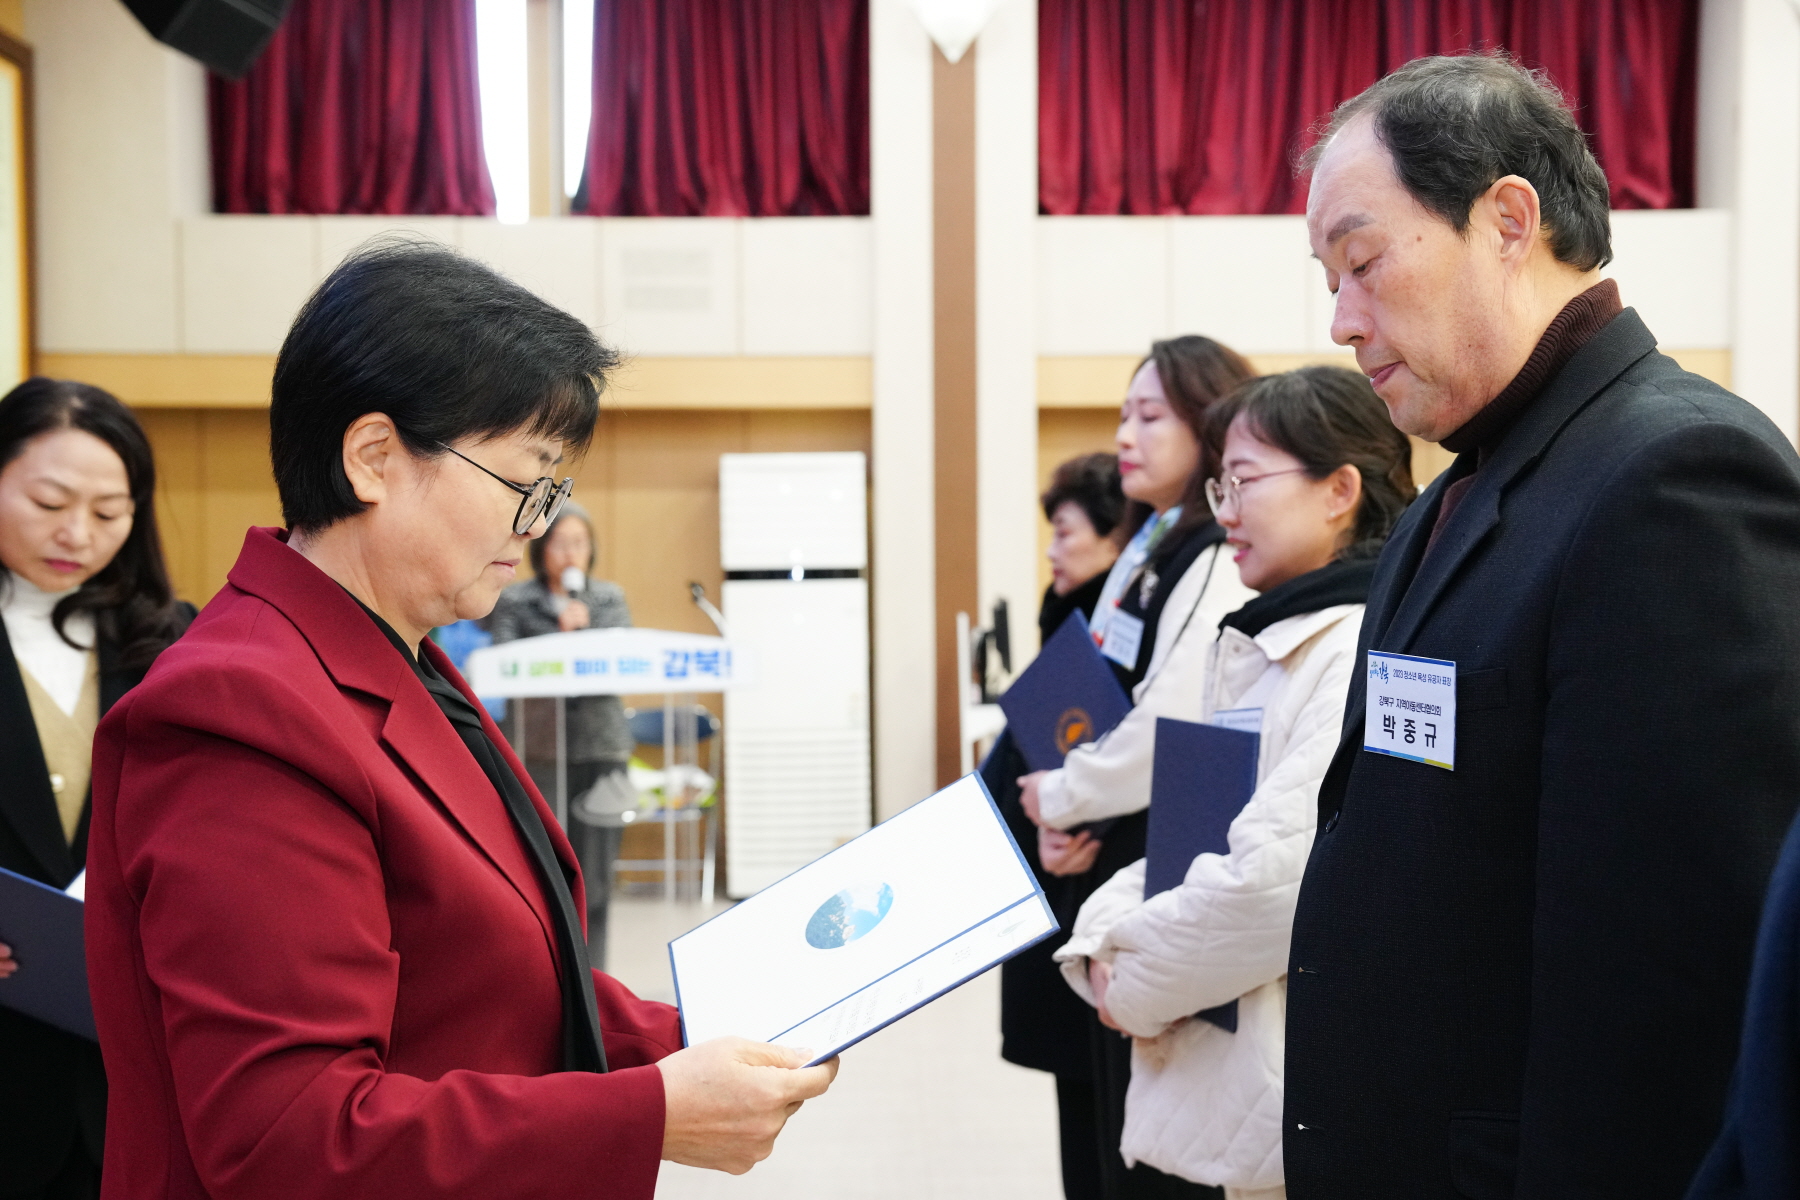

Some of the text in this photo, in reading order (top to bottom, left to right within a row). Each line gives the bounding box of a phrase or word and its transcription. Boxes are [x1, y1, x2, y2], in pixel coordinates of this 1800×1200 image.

[1403, 670, 1417, 681] 청소년
[1427, 673, 1442, 685] 유공자
[1378, 695, 1395, 707] 강북구
